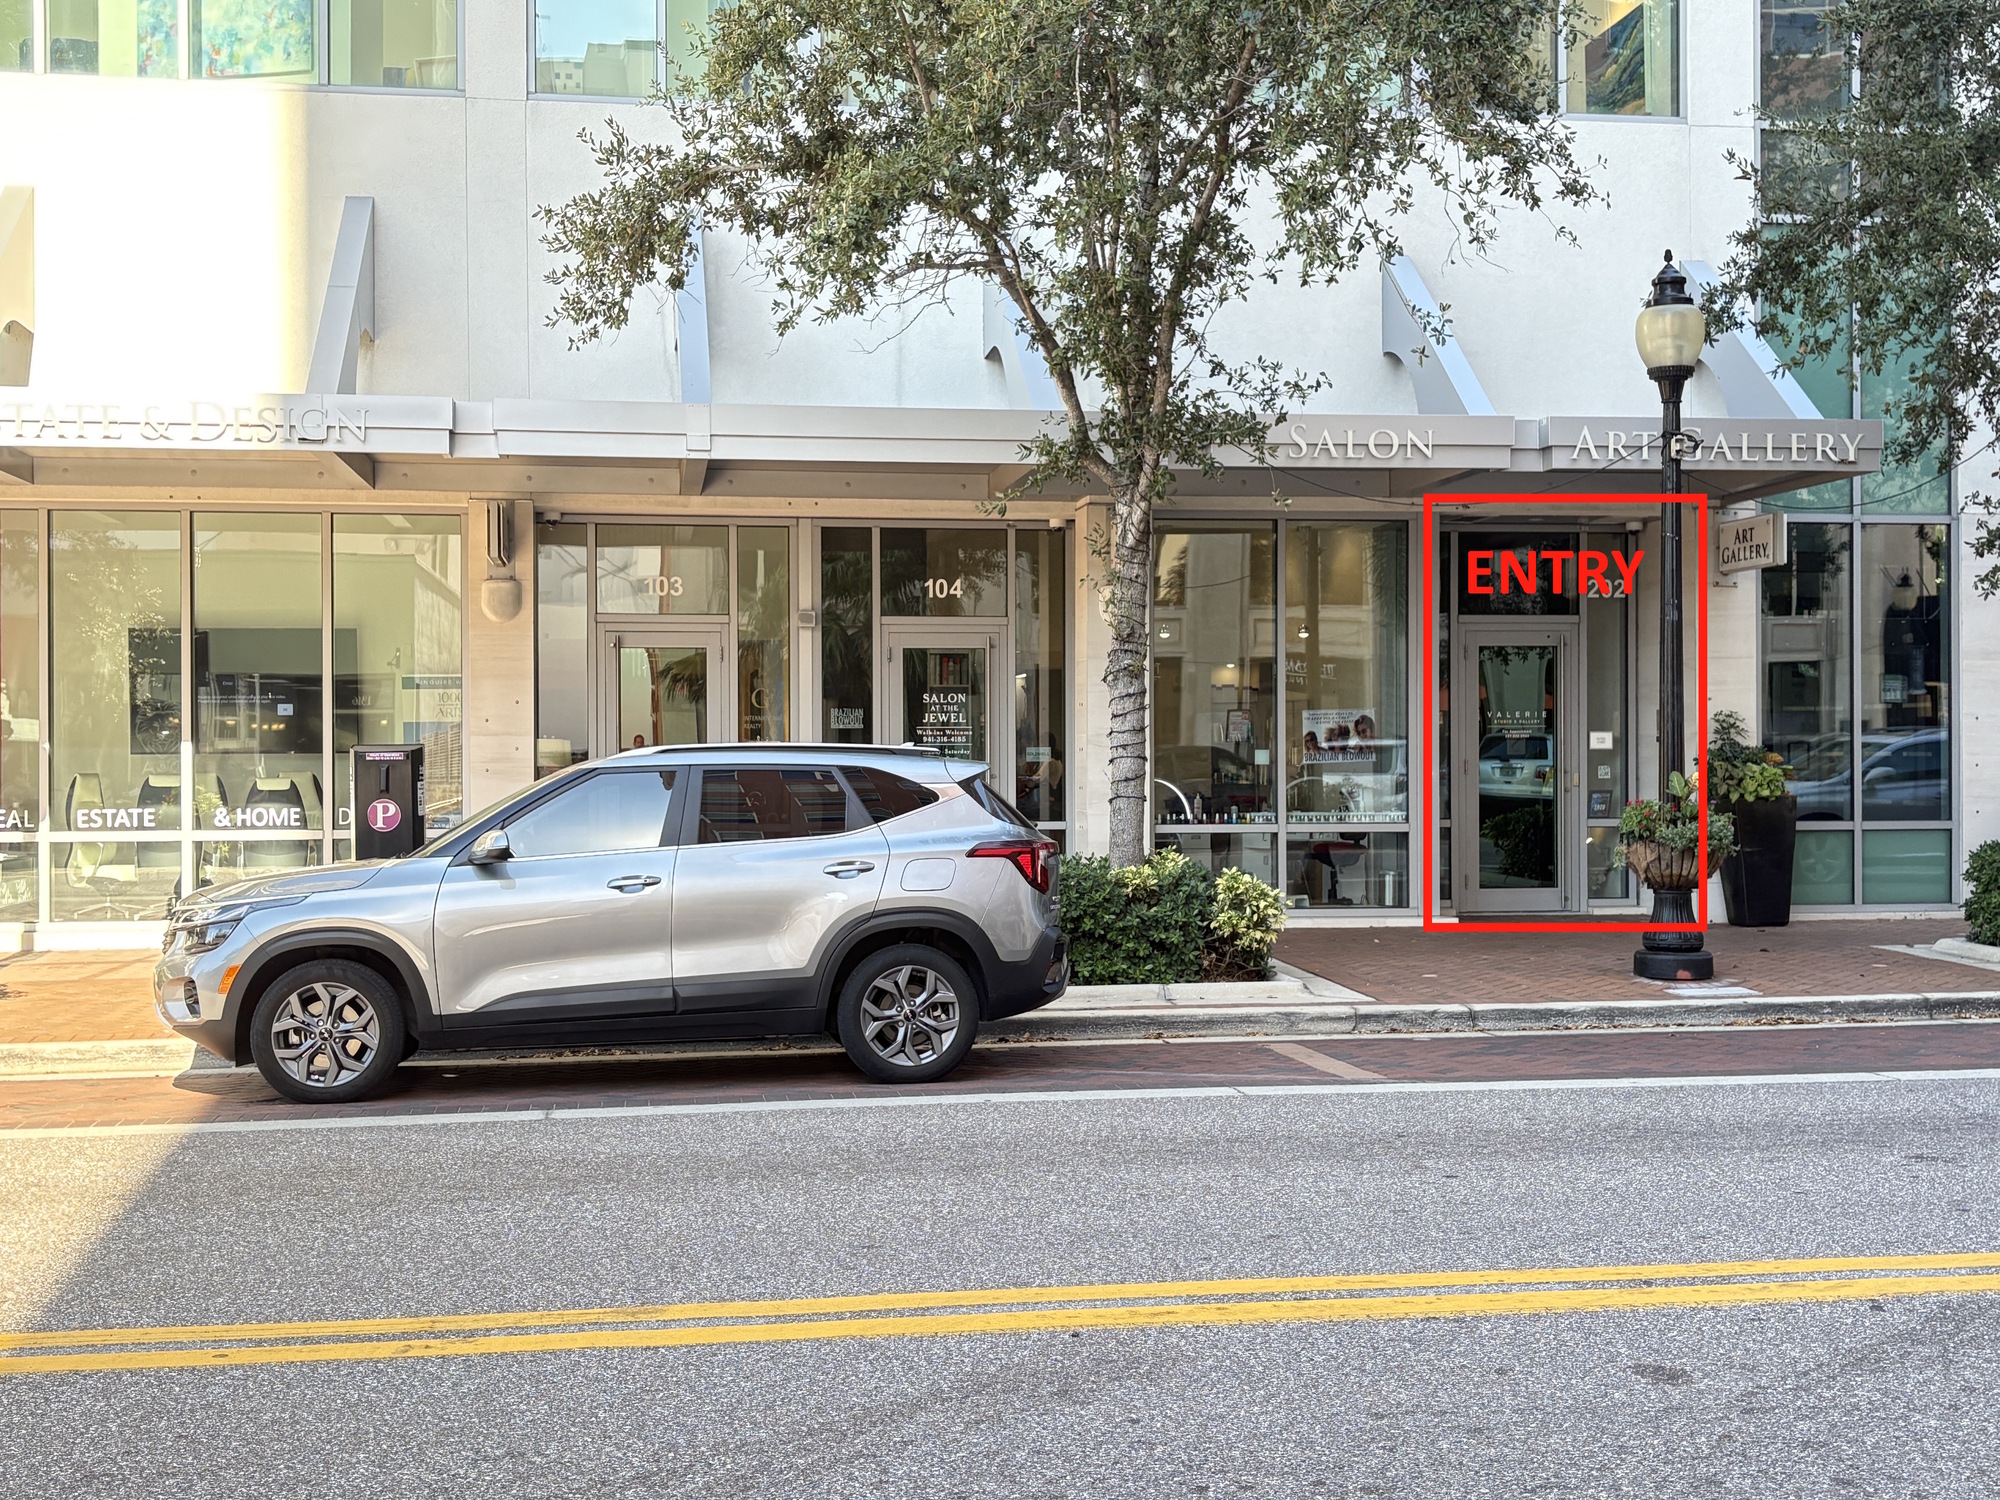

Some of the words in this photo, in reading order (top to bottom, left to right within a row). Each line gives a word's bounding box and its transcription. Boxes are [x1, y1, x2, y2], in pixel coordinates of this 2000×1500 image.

[141, 406, 174, 441] &
[190, 400, 369, 444] DESIGN
[1288, 424, 1434, 460] SALON
[1570, 425, 1658, 460] ART
[1680, 426, 1865, 463] GALLERY
[1734, 527, 1754, 545] ART
[1721, 542, 1768, 565] GALLERY
[643, 576, 683, 597] 103
[924, 578, 963, 599] 104
[922, 693, 967, 704] SALON
[942, 704, 959, 712] THE
[830, 708, 864, 717] BRAZILIAN
[830, 715, 864, 725] BLOWOUT
[922, 712, 967, 723] JEWEL
[1304, 752, 1340, 762] BRAZILIAN
[1341, 750, 1374, 761] BLOWOUT
[76, 807, 156, 828] ESTATE
[213, 807, 231, 827] &
[236, 807, 301, 827] HOME
